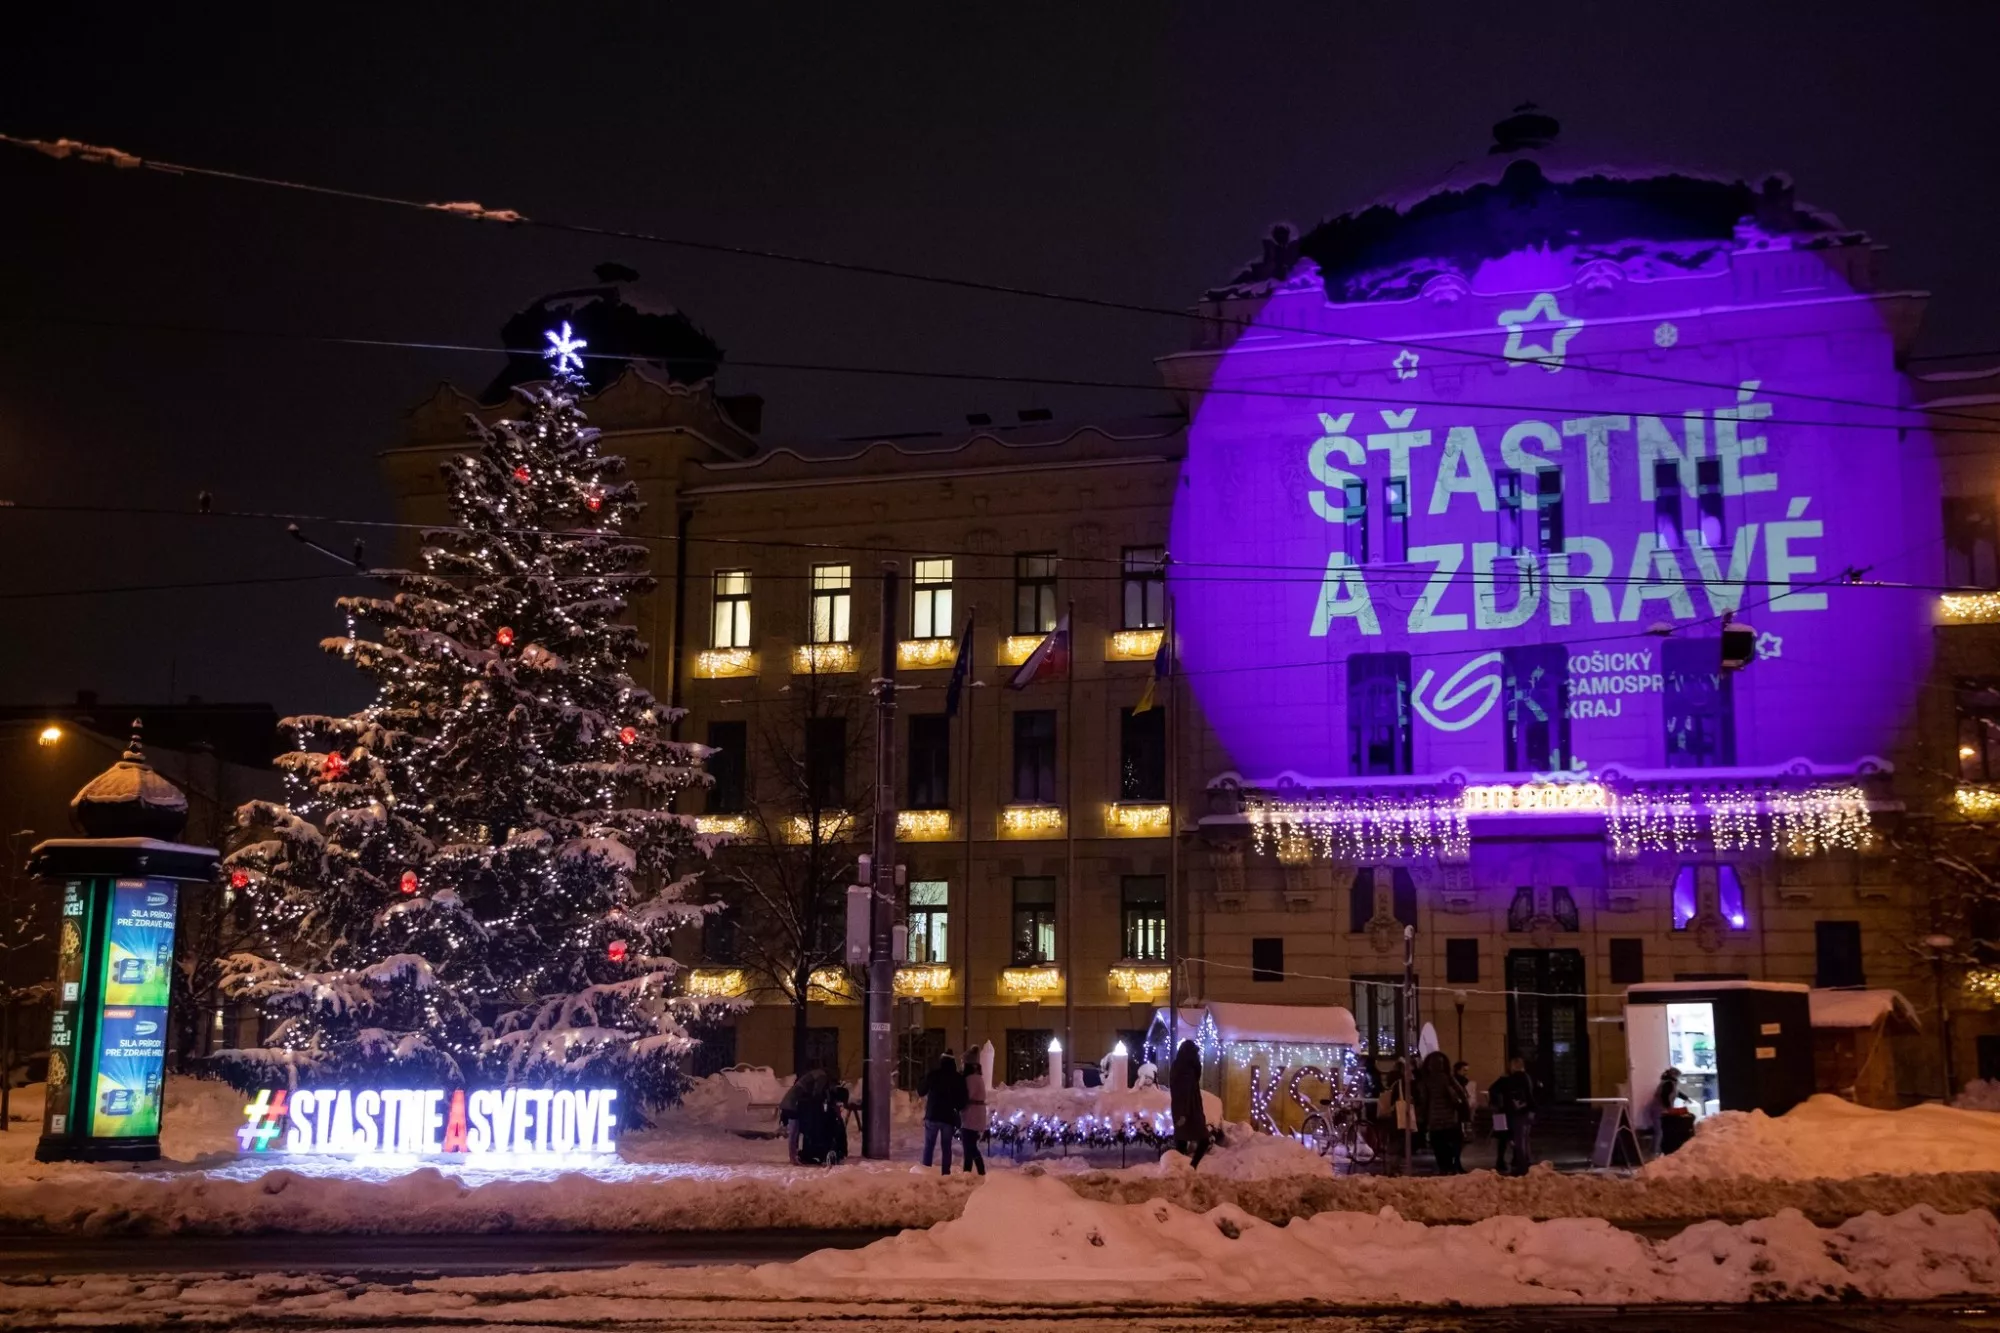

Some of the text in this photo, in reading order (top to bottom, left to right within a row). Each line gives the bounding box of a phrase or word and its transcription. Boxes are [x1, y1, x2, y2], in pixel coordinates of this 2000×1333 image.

[1307, 380, 1779, 524] ŠŤASTNÉ
[1309, 496, 1829, 637] A ZDRAVÉ
[131, 909, 149, 918] SILA
[117, 918, 134, 926] PRE
[135, 919, 163, 928] ZDRAVÉ
[120, 1039, 137, 1048] SILA
[105, 1049, 122, 1057] PRE
[124, 1048, 152, 1057] ZDRAVÉ
